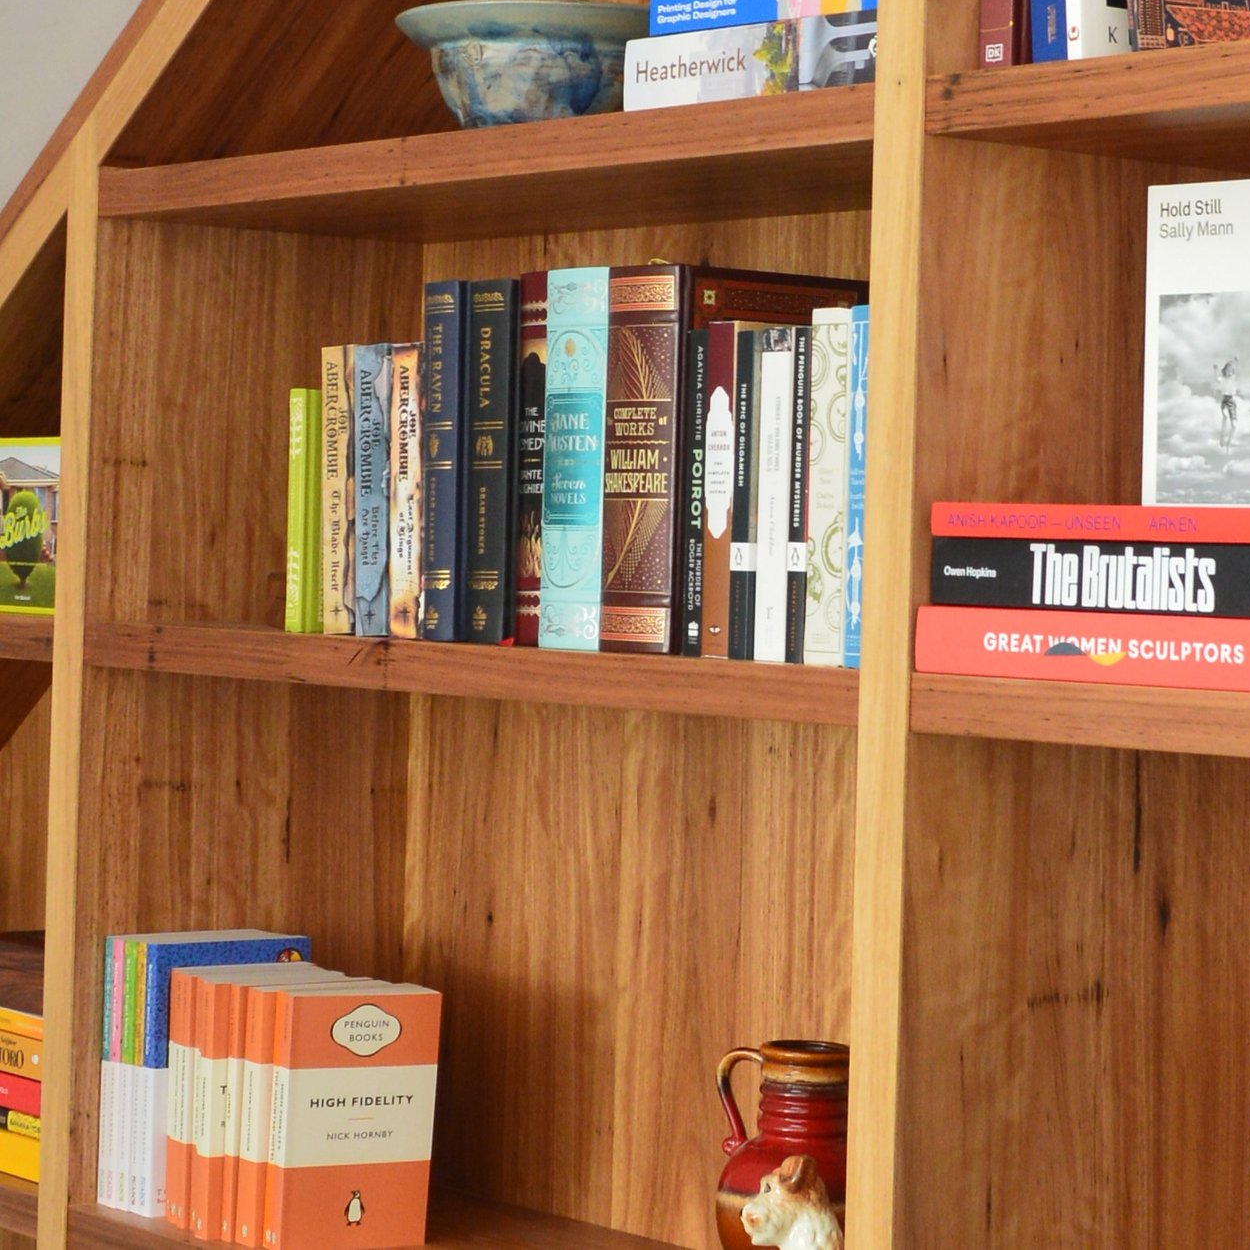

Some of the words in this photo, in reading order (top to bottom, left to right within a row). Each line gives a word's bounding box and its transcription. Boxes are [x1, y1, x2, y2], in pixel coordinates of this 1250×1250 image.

[656, 12, 691, 24] Graphic
[693, 7, 736, 20] Designers
[657, 0, 692, 14] Printing
[635, 48, 746, 84] Heatherwick
[1160, 200, 1191, 218] Hold
[1194, 198, 1222, 216] Still
[1160, 222, 1194, 242] Sally
[1197, 220, 1234, 237] Mann
[432, 323, 443, 357] THE
[479, 326, 491, 408] DRACULA
[696, 346, 704, 390] AGATHA
[797, 355, 805, 396] PENGUIN
[431, 361, 442, 413] RAVEN
[325, 362, 338, 480] ABERCROMBIE
[339, 407, 348, 434] JOE
[525, 407, 539, 417] THE
[551, 413, 589, 432] JANE
[613, 407, 657, 420] COMPLETE
[694, 392, 703, 441] CHRISTIE
[739, 401, 747, 420] EPIC
[796, 399, 804, 425] BOOK
[360, 370, 372, 497] ABERCROMBIE
[371, 418, 380, 449] JOE
[398, 365, 409, 482] ABERCROMBIE
[614, 422, 655, 437] WORKS
[739, 423, 746, 434] OF
[796, 428, 803, 440] OF
[546, 434, 598, 452] AUSTEN
[610, 449, 659, 470] WILLIAM
[737, 436, 746, 487] GILGAMESH
[794, 442, 802, 479] MURDER
[552, 472, 586, 489] Seven
[605, 472, 668, 494] SHAKESPEARE
[691, 449, 703, 529] POIROT
[329, 490, 340, 515] The
[551, 493, 586, 505] NOVELS
[793, 482, 801, 527] MYSTERIES
[362, 508, 370, 527] Are
[371, 507, 380, 537] Before
[947, 514, 986, 526] ANISH
[990, 515, 1047, 529] KAPOOR
[1065, 515, 1121, 531] UNSEEN
[1150, 517, 1198, 532] ARKEN
[331, 519, 340, 555] Blade
[688, 539, 696, 568] ROGER
[330, 561, 340, 592] Itself
[694, 559, 702, 592] MURDER
[944, 565, 966, 577] Owen
[966, 566, 997, 580] Hopkins
[1030, 543, 1080, 606] The
[1081, 545, 1216, 613] Brutalists
[694, 594, 702, 606] OF
[983, 632, 1043, 653] GREAT
[1048, 635, 1122, 655] WOMEN
[1127, 640, 1245, 665] SCULPTORS
[344, 1020, 390, 1029] PENGUIN
[349, 1034, 384, 1042] BOOKS
[310, 1098, 346, 1108] HIGH
[351, 1094, 414, 1107] FIDELITY
[326, 1132, 350, 1141] NICK
[353, 1130, 393, 1139] HORNBY
